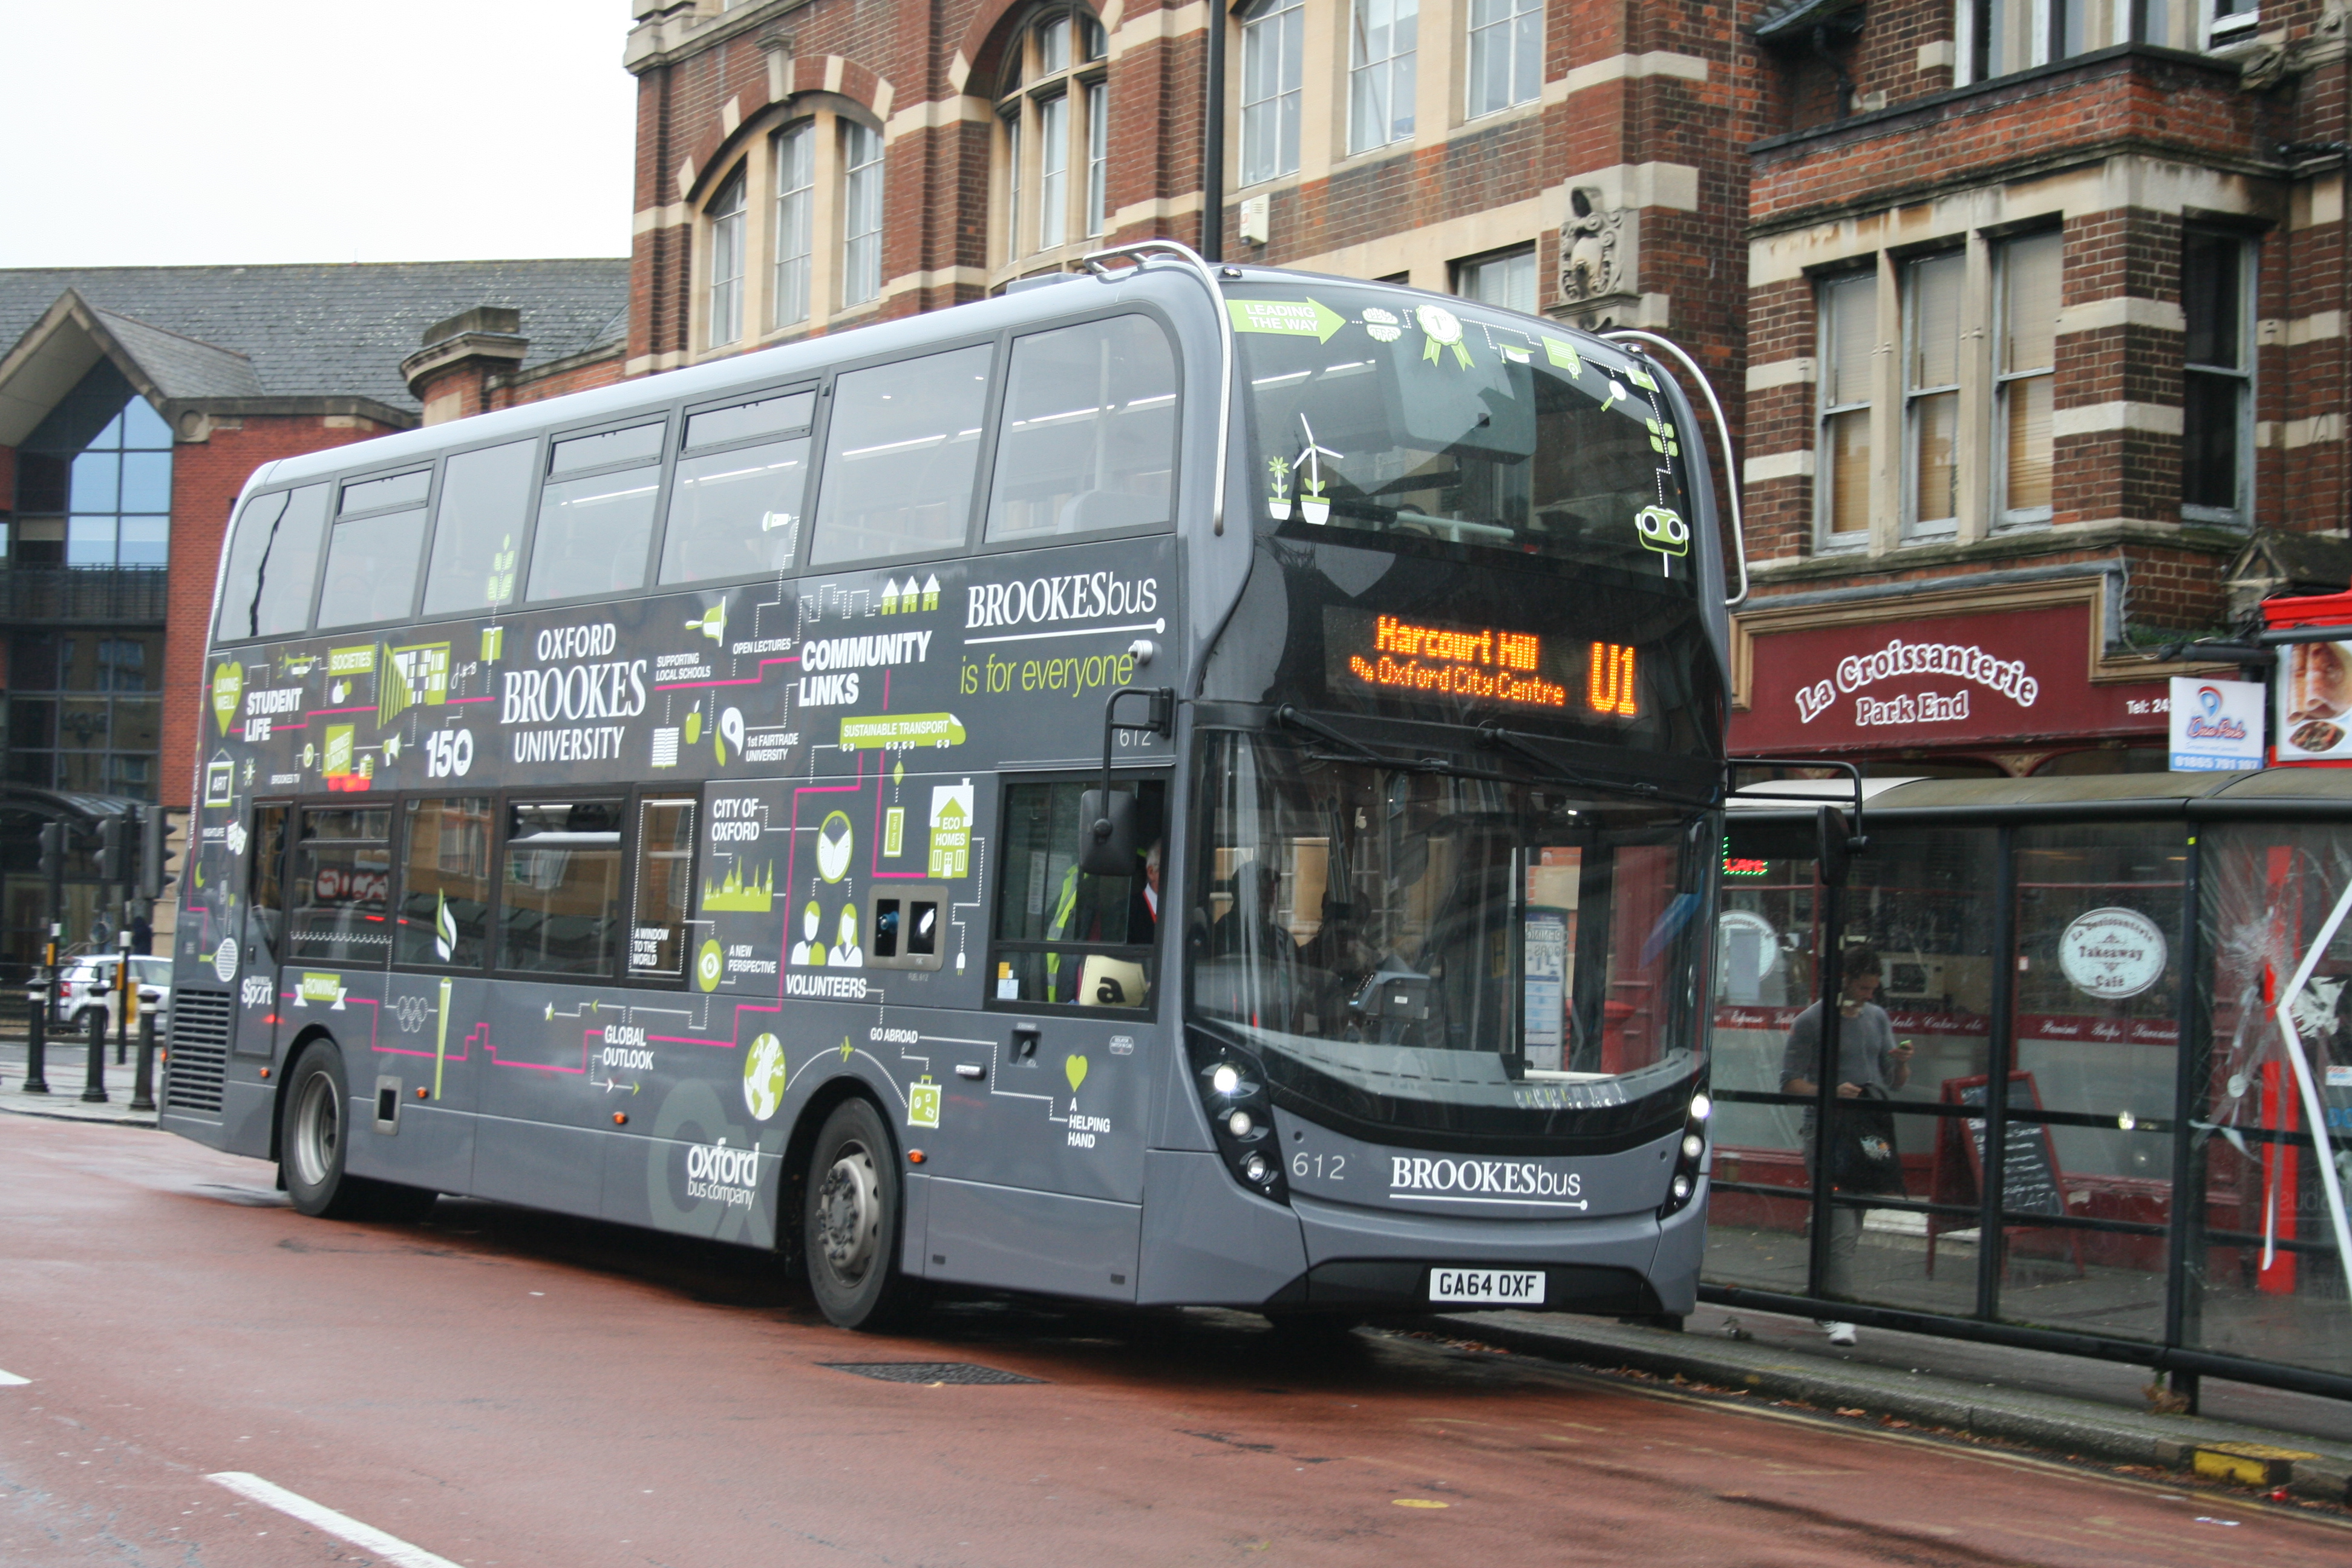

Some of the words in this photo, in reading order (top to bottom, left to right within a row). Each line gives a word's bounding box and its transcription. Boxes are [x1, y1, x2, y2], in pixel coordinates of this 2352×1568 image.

[1244, 304, 1316, 318] LEADING
[1248, 316, 1284, 330] THE
[1285, 318, 1319, 332] WAY
[965, 570, 1157, 629] BROOKESbus
[537, 622, 617, 661] OXFORD
[733, 641, 753, 655] OPEN
[754, 638, 791, 653] LECTURES
[802, 630, 933, 672] COMMUNITY
[1376, 614, 1492, 664] Harcourt
[1497, 631, 1539, 671] Hill
[331, 650, 373, 671] SOCIETIES
[656, 653, 701, 668] SUPPORTING
[656, 668, 679, 682] LOCAL
[679, 665, 711, 681] SCHOOLS
[961, 657, 978, 694] is
[985, 653, 1016, 694] for
[1021, 653, 1133, 698] everyone
[1377, 655, 1451, 691] Oxford
[1454, 665, 1493, 697] City
[1497, 671, 1566, 707] Centre
[1590, 641, 1637, 715] U1
[1795, 679, 1836, 724] La
[1836, 639, 2039, 708] Croissanterie
[216, 677, 240, 693] LIVING
[501, 659, 647, 724] BROOKES
[798, 672, 859, 707] LINKS
[215, 694, 237, 711] WELL
[246, 687, 304, 716] STUDENT
[1855, 694, 1916, 727] Park
[1917, 690, 1970, 724] End
[2126, 699, 2150, 715] Tel:
[2152, 697, 2171, 713] 24
[244, 717, 272, 742] LIFE
[843, 722, 898, 737] SUSTAINABLE
[898, 720, 949, 736] TRANSPORT
[1120, 728, 1151, 747] 612
[513, 726, 626, 763] UNIVERSITY
[747, 736, 758, 747] 1st
[758, 733, 799, 746] FAIRTRADE
[425, 728, 474, 778] 150
[745, 748, 789, 762] UNIVERSITY
[212, 776, 229, 791] ART
[270, 773, 293, 785] BROOKES
[713, 799, 741, 819] CITY
[742, 798, 759, 818] OF
[711, 821, 760, 842] OXFORD
[942, 817, 961, 830] ECO
[935, 832, 966, 846] HOMES
[634, 928, 640, 939] A
[640, 928, 670, 941] WINDOW
[634, 941, 644, 953] TO
[644, 941, 658, 953] THE
[729, 944, 736, 957] A
[735, 944, 754, 958] NEW
[2079, 945, 2145, 961] Takeaway
[632, 953, 658, 966] WORLD
[728, 959, 777, 975] PERSPECTIVE
[241, 978, 274, 1010] Sport
[304, 977, 338, 996] ROWING
[786, 974, 867, 999] VOLUNTEERS
[605, 1024, 647, 1047] GLOBAL
[870, 1028, 883, 1042] GO
[883, 1028, 919, 1044] ABROAD
[603, 1047, 654, 1070] OUTLOOK
[1070, 1097, 1077, 1112] A
[1068, 1114, 1111, 1133] HELPING
[1068, 1131, 1096, 1149] HAND
[687, 1136, 760, 1187] oxford
[1292, 1152, 1346, 1181] 612
[1390, 1155, 1581, 1196] BROOKESbus
[687, 1176, 707, 1197] bus
[707, 1183, 756, 1211] company
[1439, 1273, 1493, 1298] GA64
[1498, 1275, 1538, 1298] OXF
